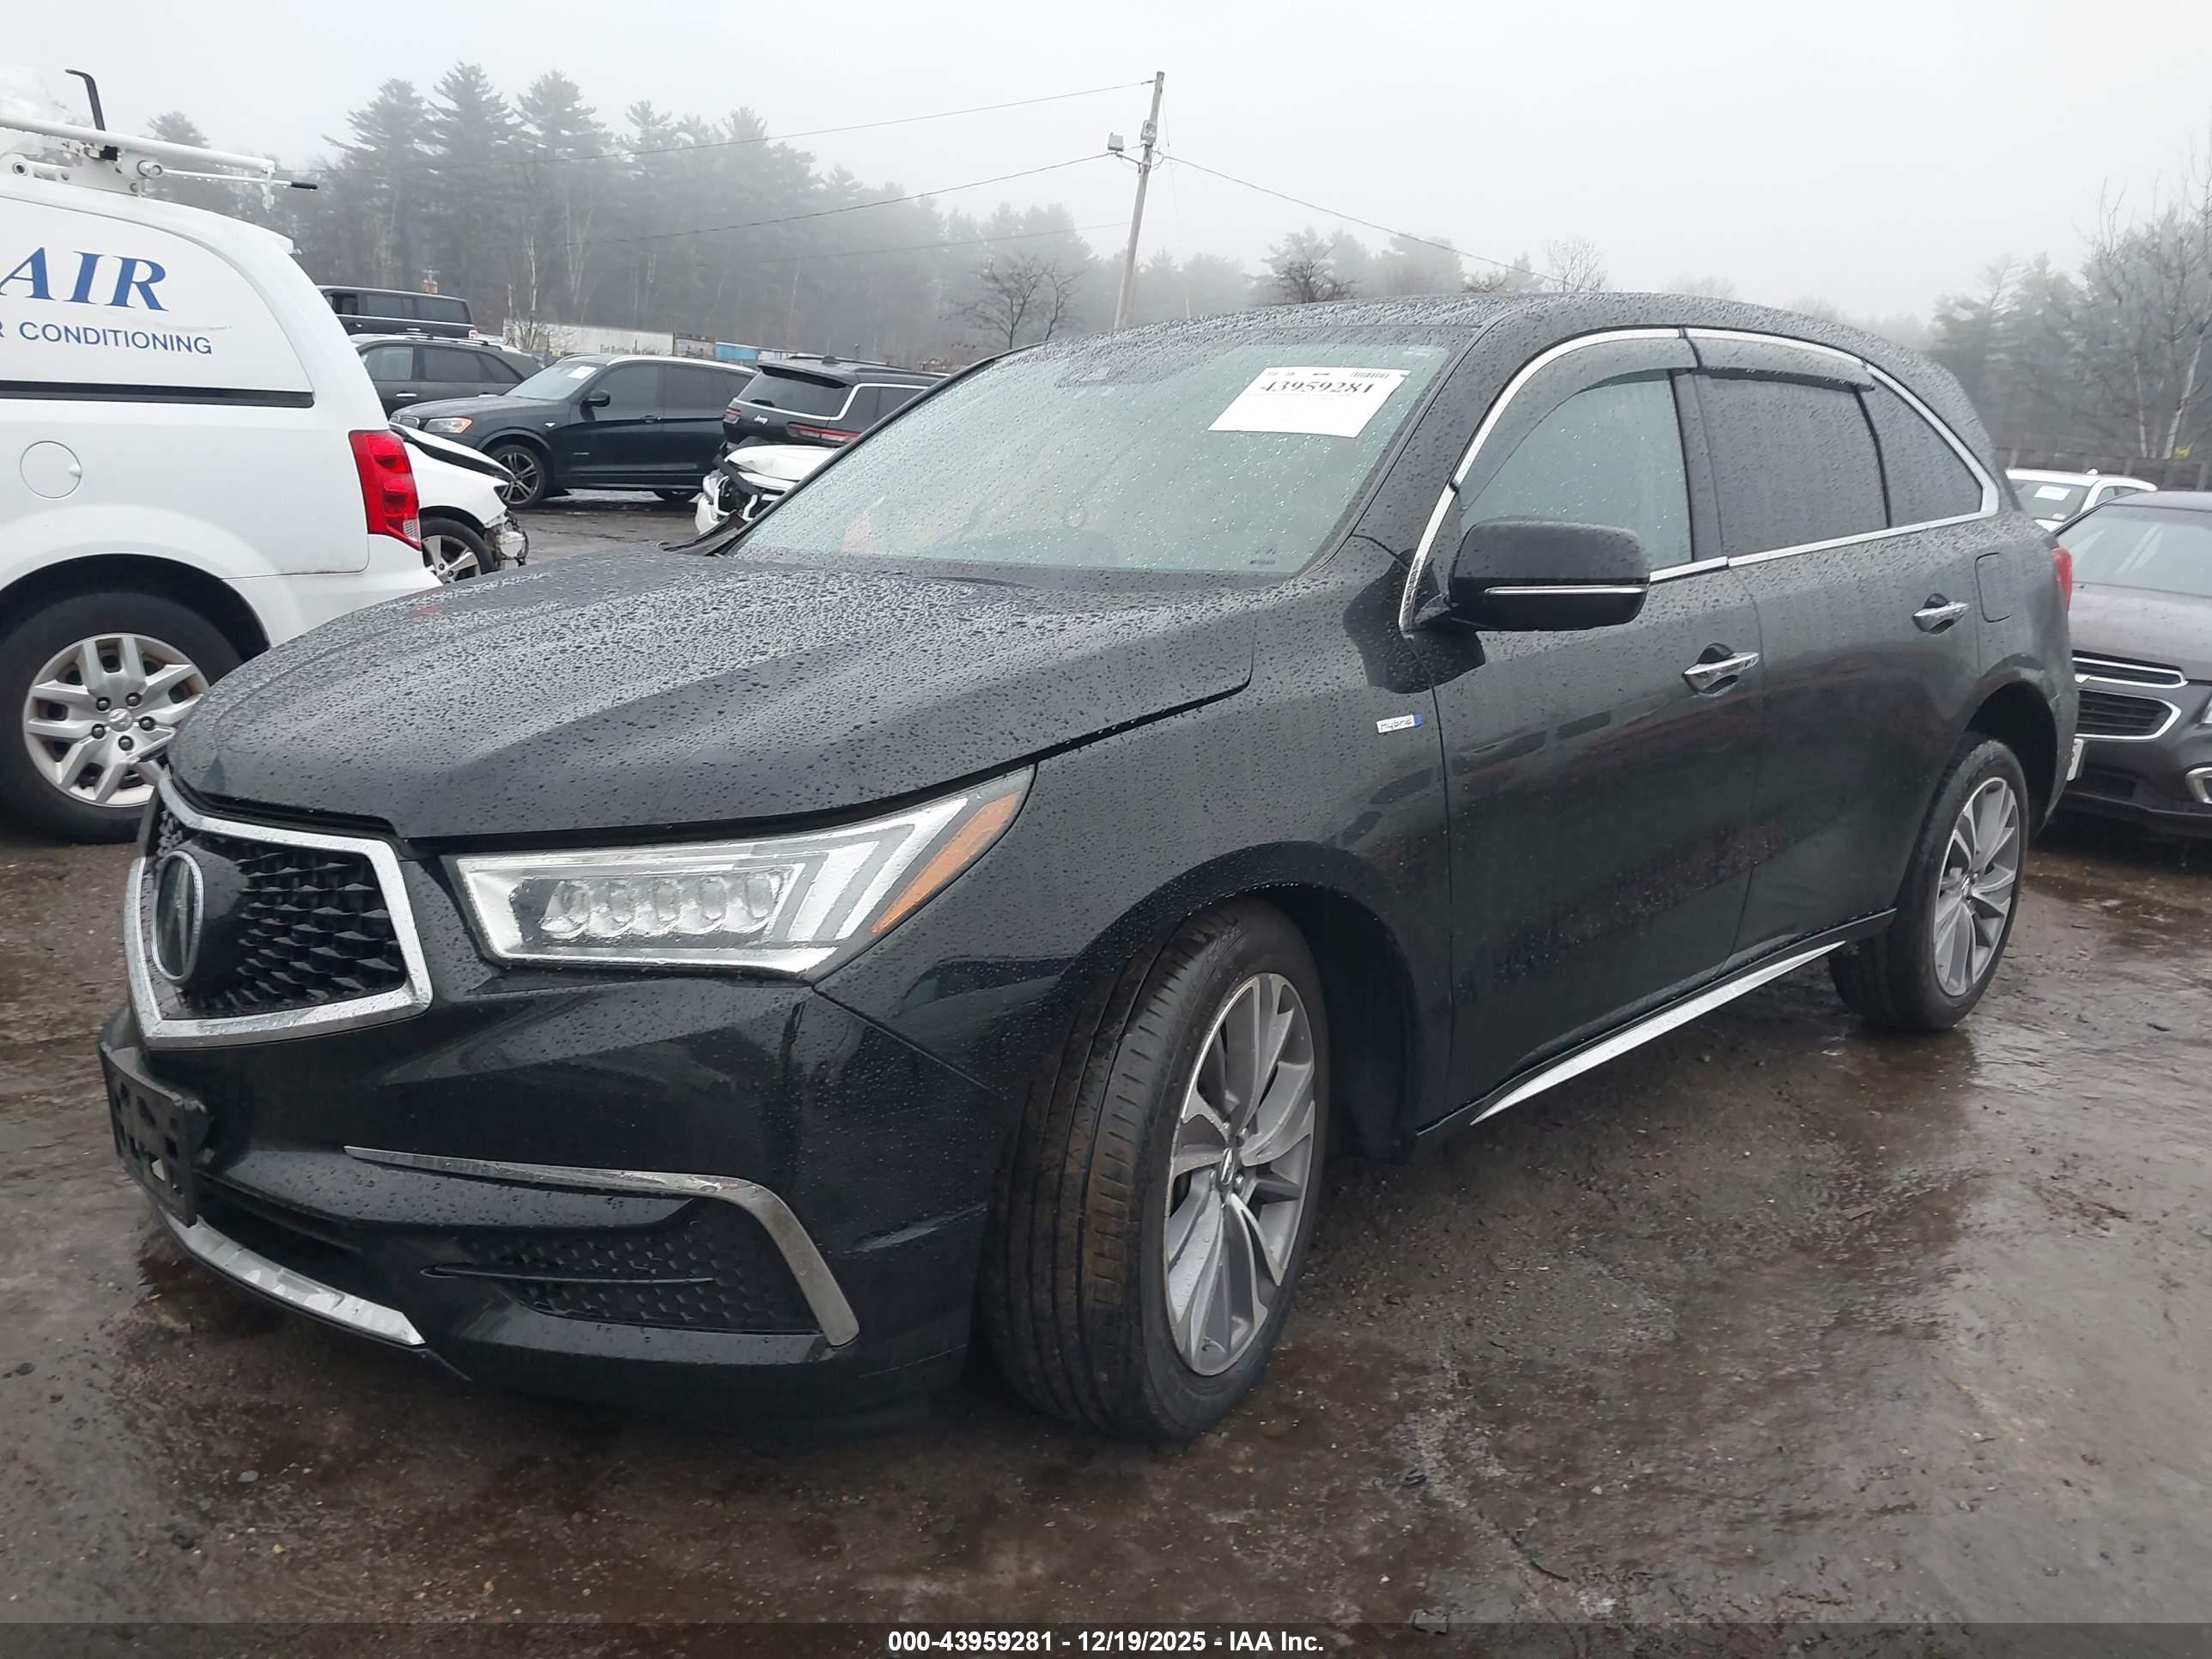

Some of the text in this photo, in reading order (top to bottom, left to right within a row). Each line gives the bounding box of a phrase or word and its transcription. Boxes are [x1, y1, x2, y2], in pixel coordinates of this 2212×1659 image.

[0, 246, 169, 312] AIR
[19, 321, 213, 355] CONDITIONING
[1261, 380, 1374, 393] 43959281
[754, 415, 769, 425] Jeep
